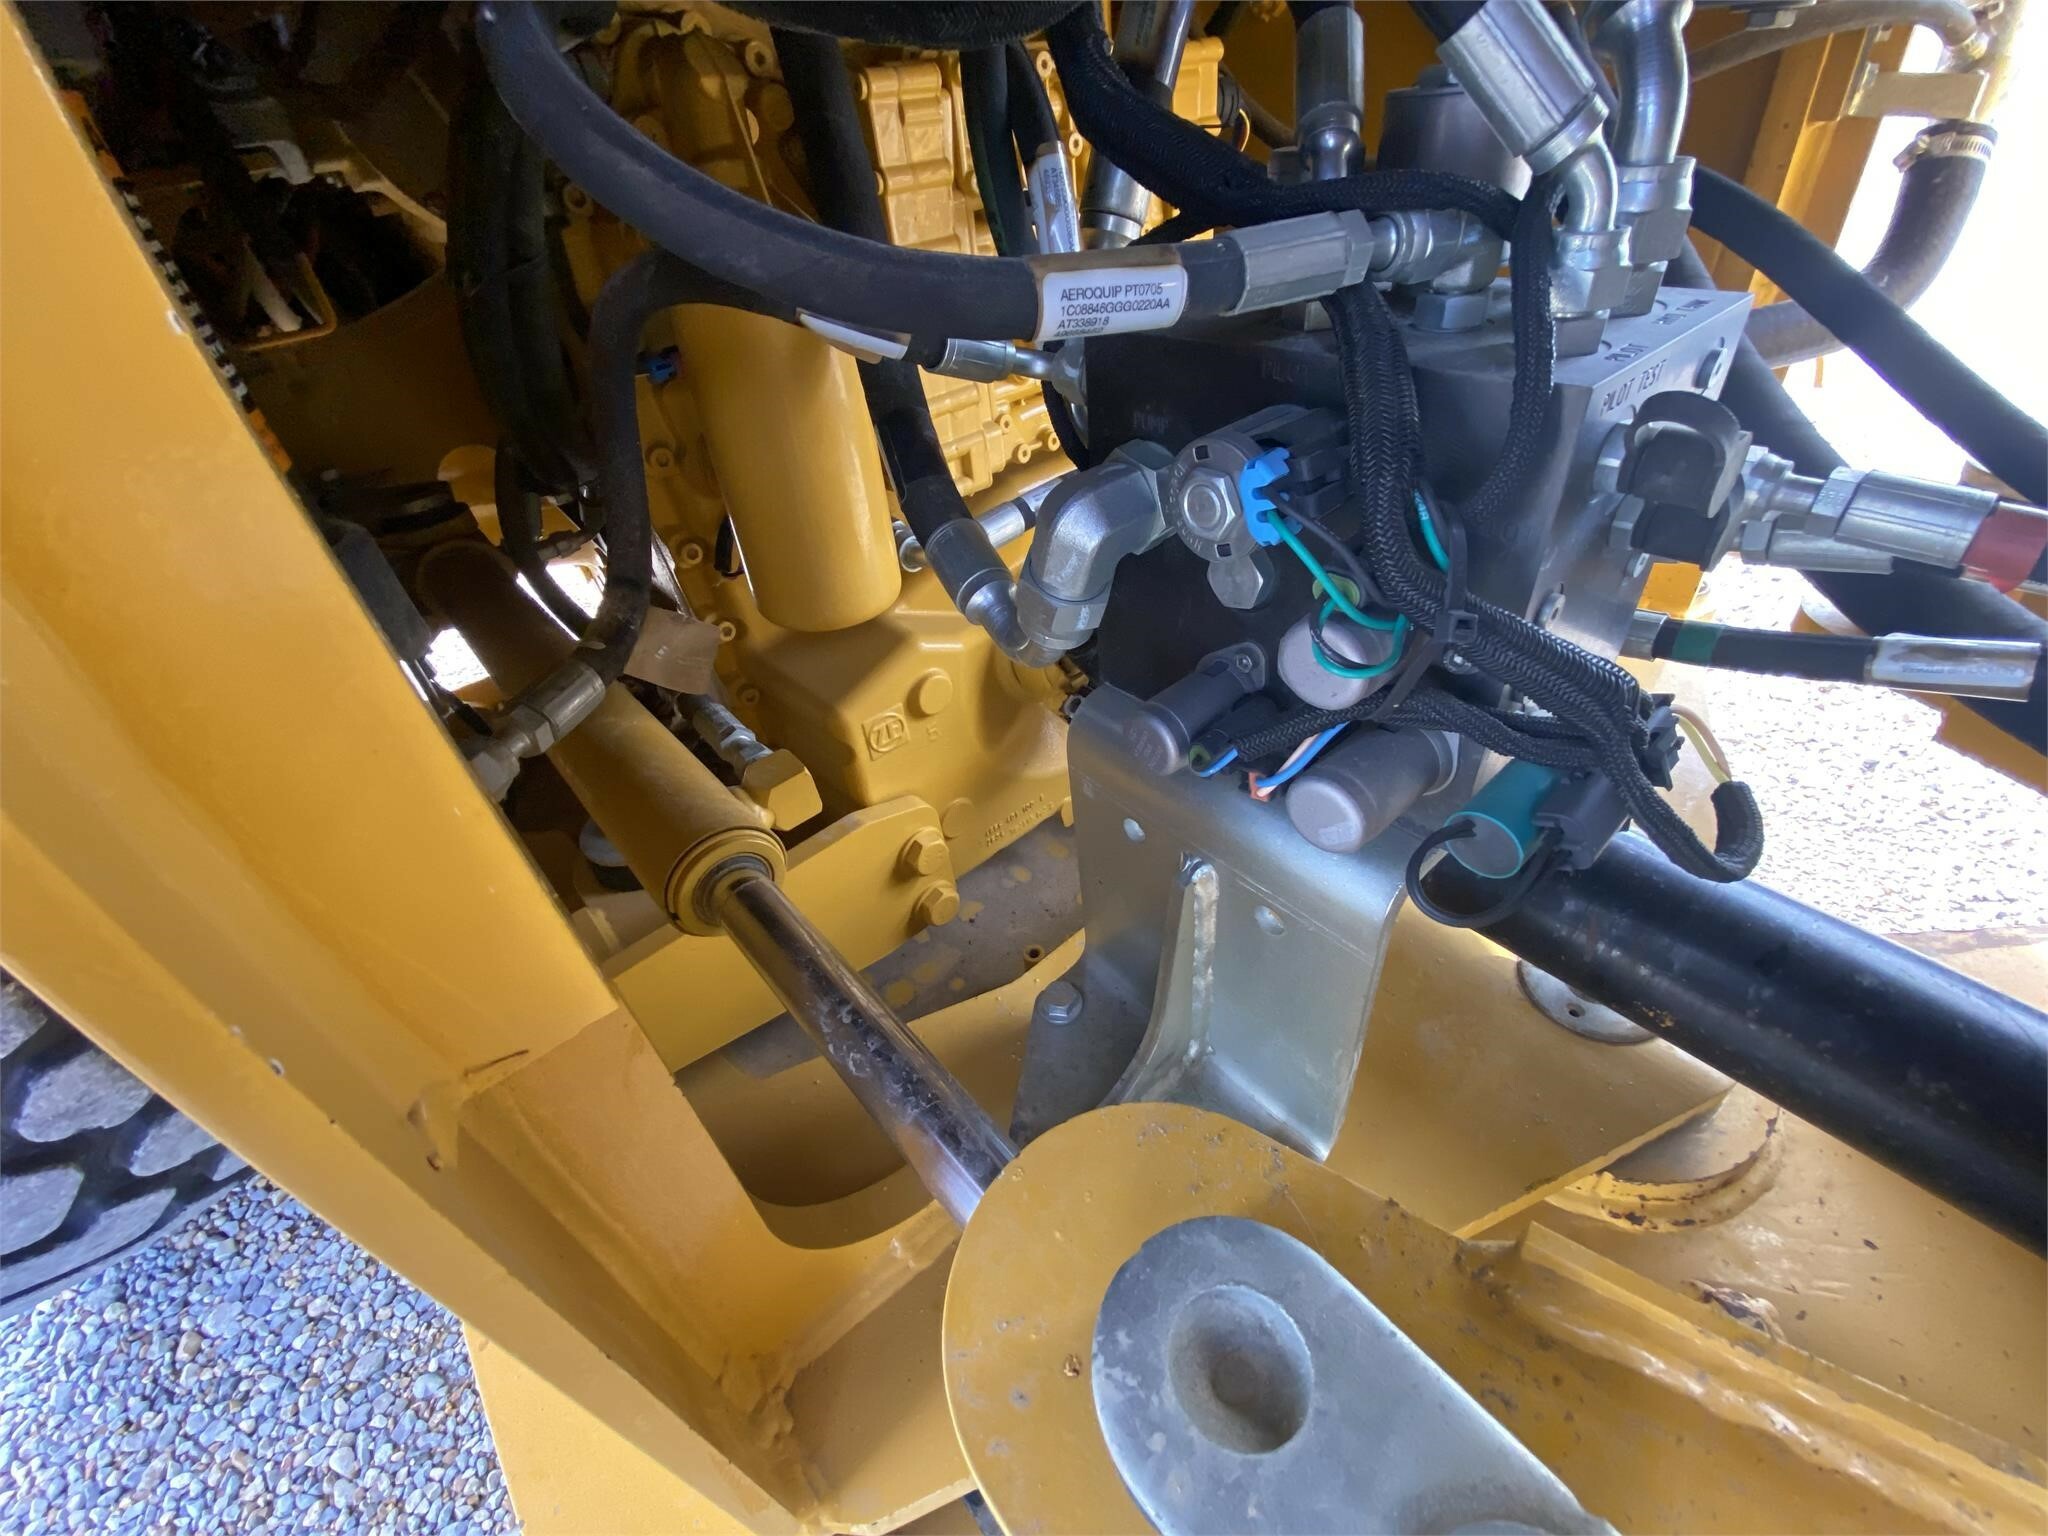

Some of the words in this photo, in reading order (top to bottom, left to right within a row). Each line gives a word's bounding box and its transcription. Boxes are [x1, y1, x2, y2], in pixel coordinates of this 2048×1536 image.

[1060, 284, 1123, 301] AEROQUIP
[1124, 282, 1163, 298] PT0705
[1601, 378, 1635, 417] PILOT
[1637, 359, 1668, 394] TEST
